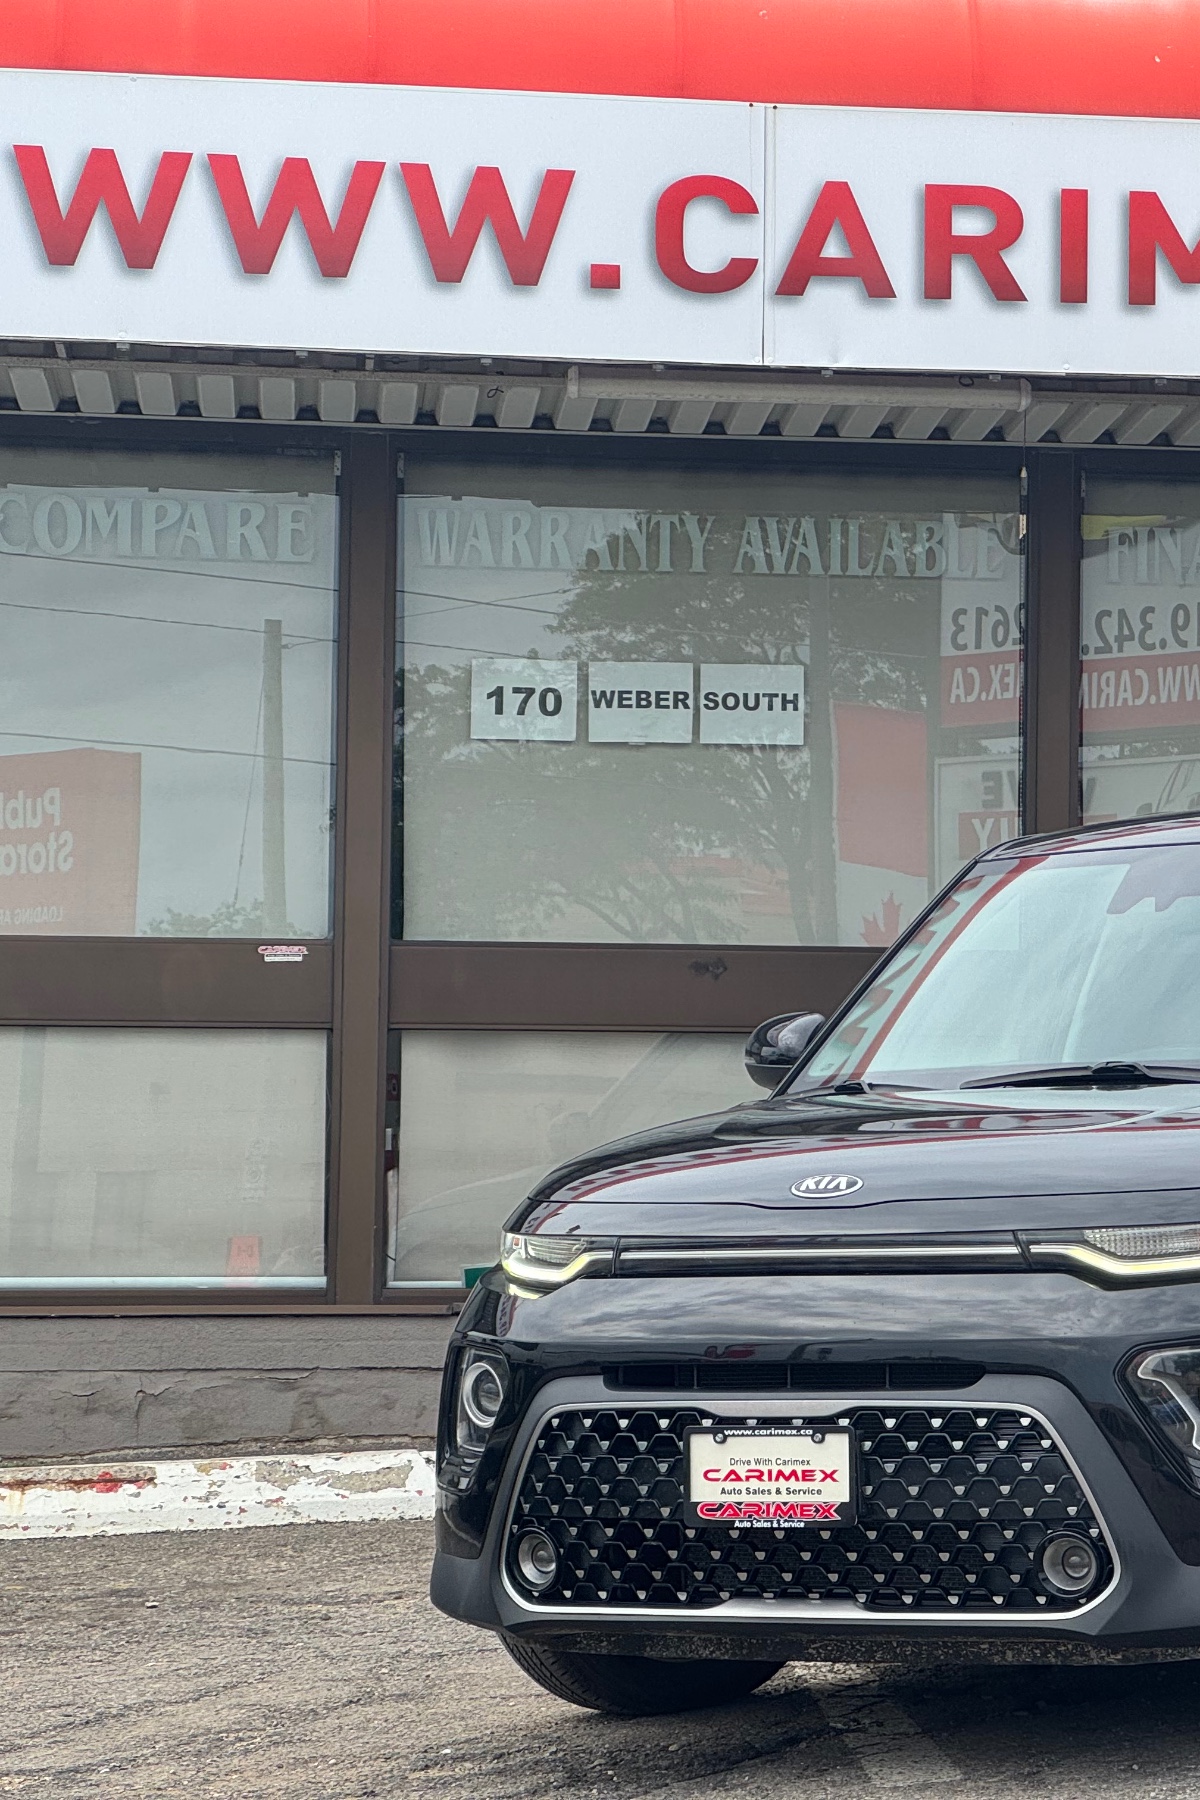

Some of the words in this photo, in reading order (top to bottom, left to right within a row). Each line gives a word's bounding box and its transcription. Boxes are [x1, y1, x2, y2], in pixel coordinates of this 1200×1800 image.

[416, 507, 717, 574] WARRANTY
[732, 515, 1006, 579] AVAILABLE
[485, 686, 564, 717] 170
[590, 689, 691, 711] WEBER
[702, 691, 799, 712] SOUTH
[799, 1175, 849, 1191] KIA
[724, 1428, 813, 1436] www.carimex.ca
[729, 1458, 751, 1466] Drive
[754, 1458, 772, 1466] With
[775, 1458, 811, 1466] Carimex
[703, 1468, 839, 1483] CARIMEX
[720, 1487, 742, 1496] Auto
[745, 1487, 772, 1496] Sales
[775, 1487, 782, 1496] &
[785, 1487, 822, 1496] Service
[698, 1501, 841, 1521] CARIMEX
[734, 1520, 750, 1528] Auto
[752, 1520, 771, 1528] Sales
[772, 1520, 778, 1528] &
[779, 1520, 805, 1528] Service
